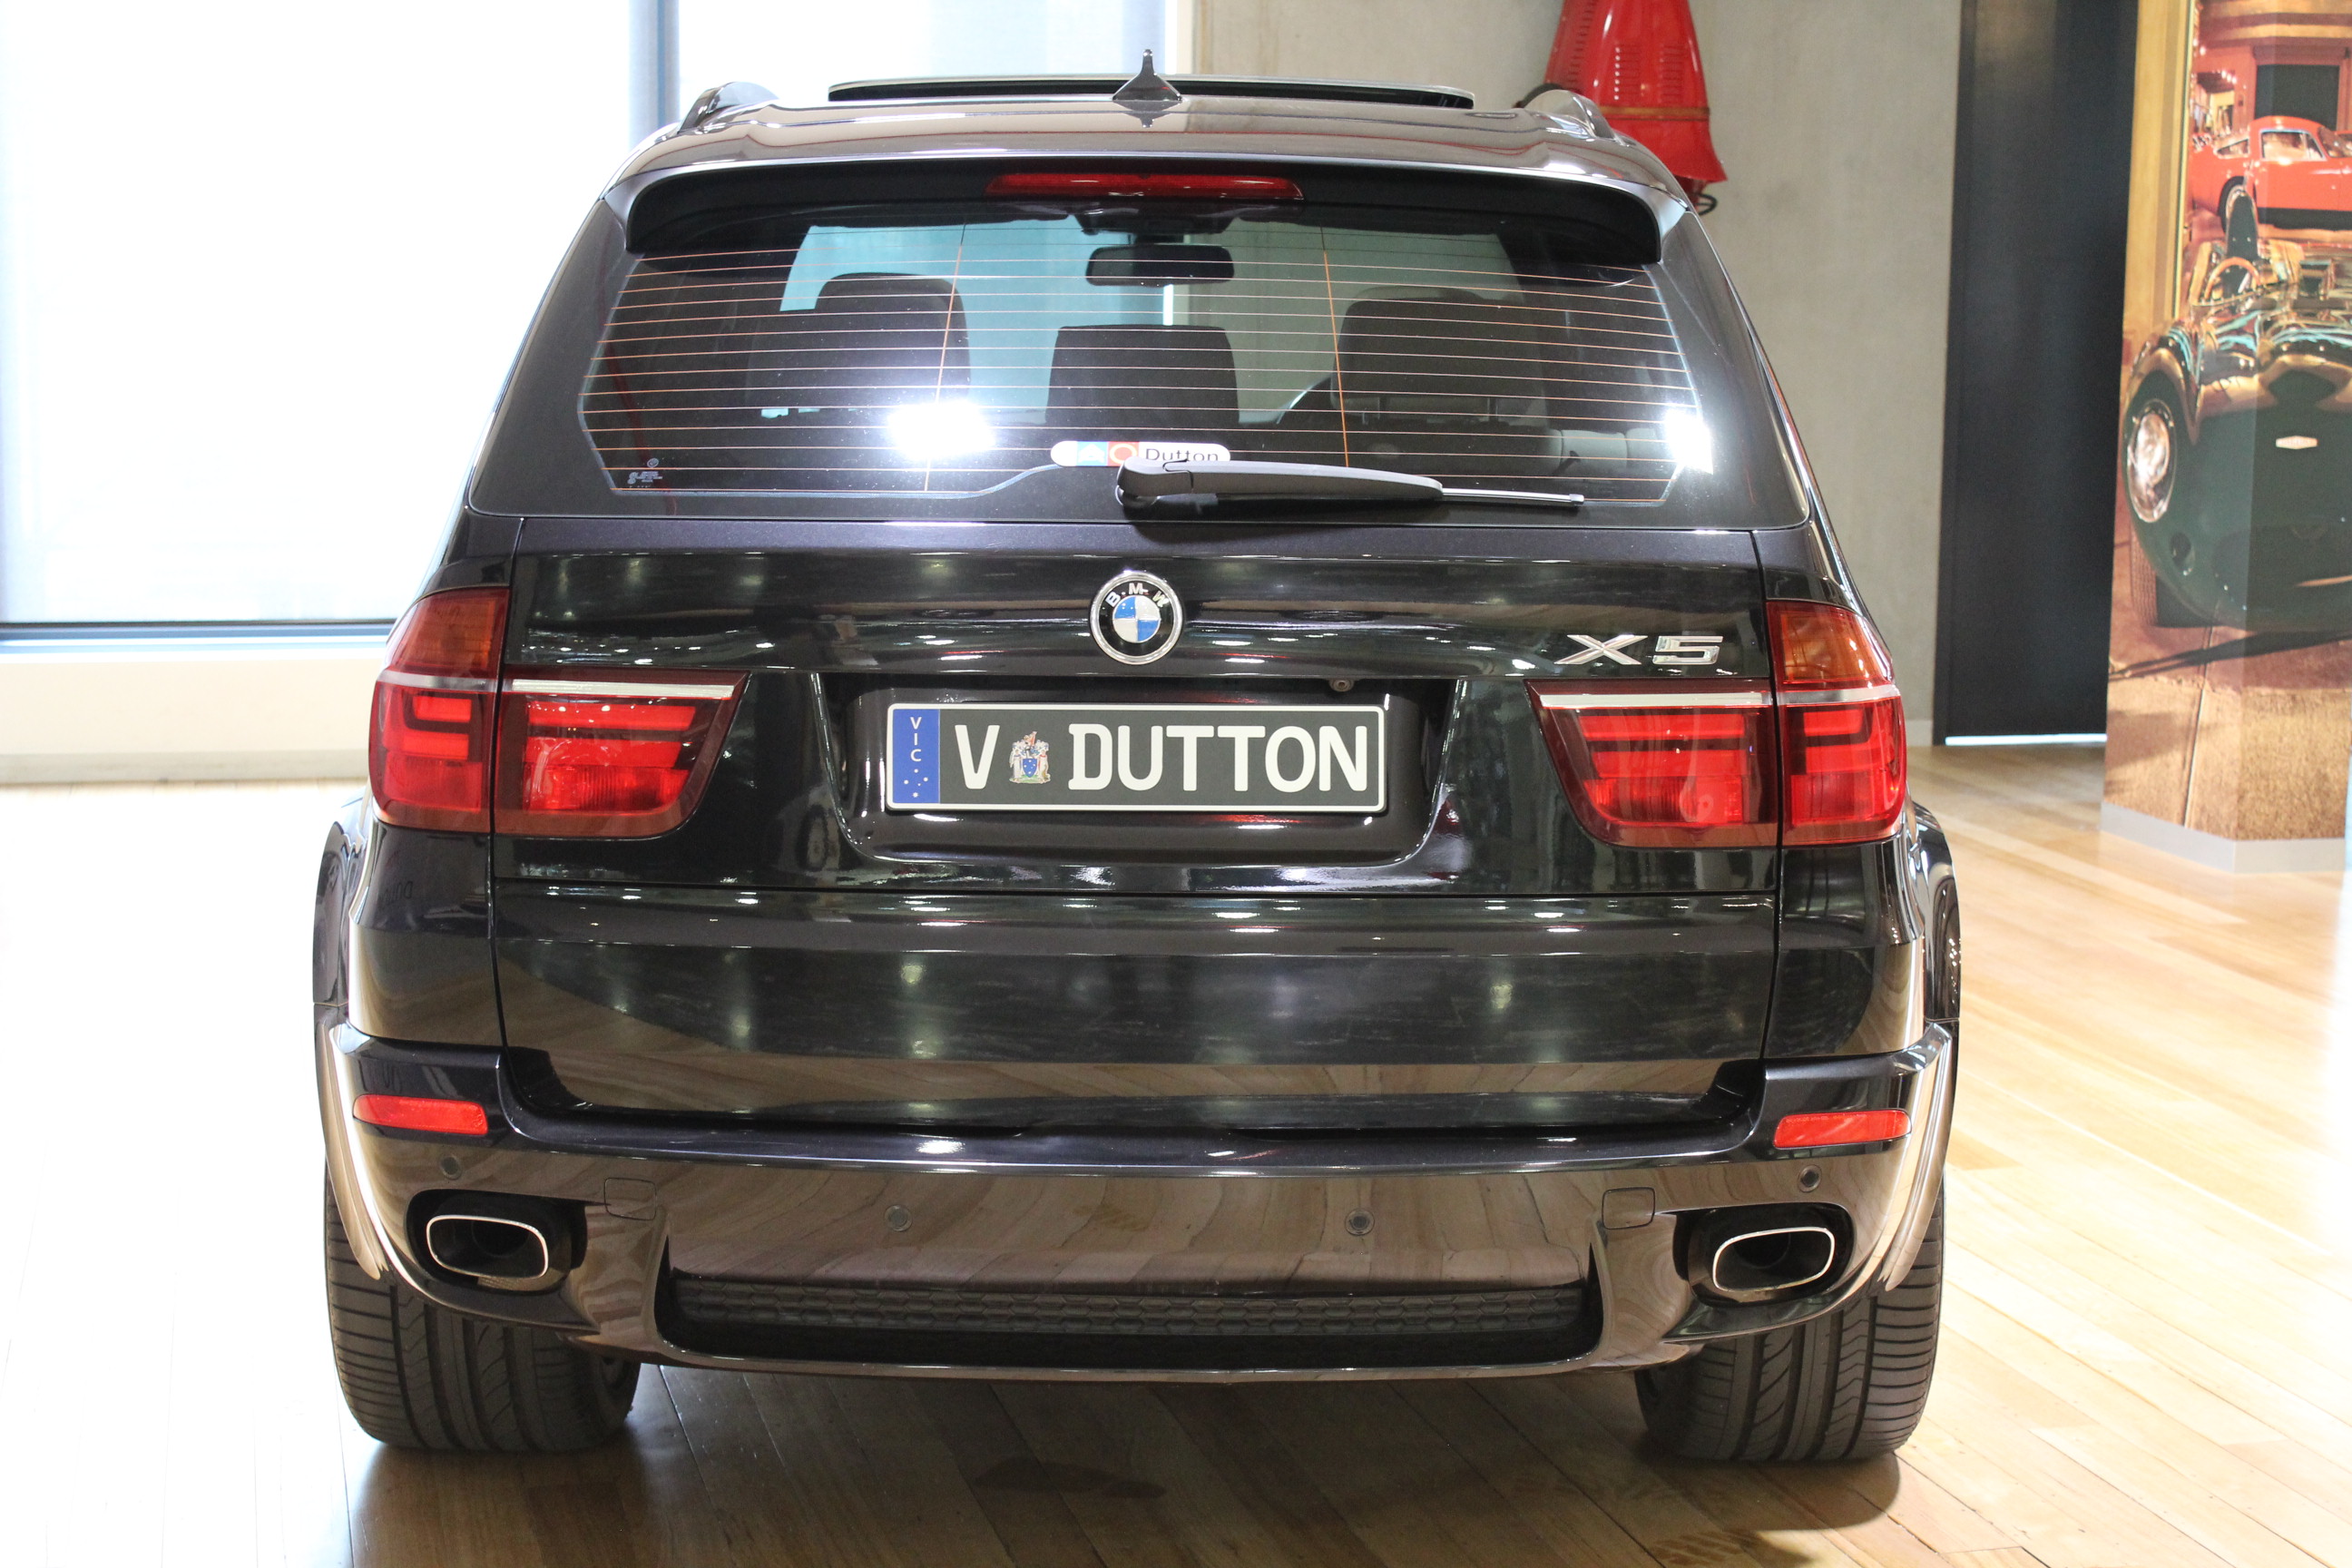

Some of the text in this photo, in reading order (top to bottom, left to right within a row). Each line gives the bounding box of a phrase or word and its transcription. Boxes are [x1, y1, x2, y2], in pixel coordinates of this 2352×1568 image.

[1145, 447, 1219, 461] Dutton
[1105, 583, 1169, 607] BMW
[1553, 634, 1723, 665] X5
[910, 716, 922, 762] VIC
[955, 723, 1367, 792] V DUTTON
